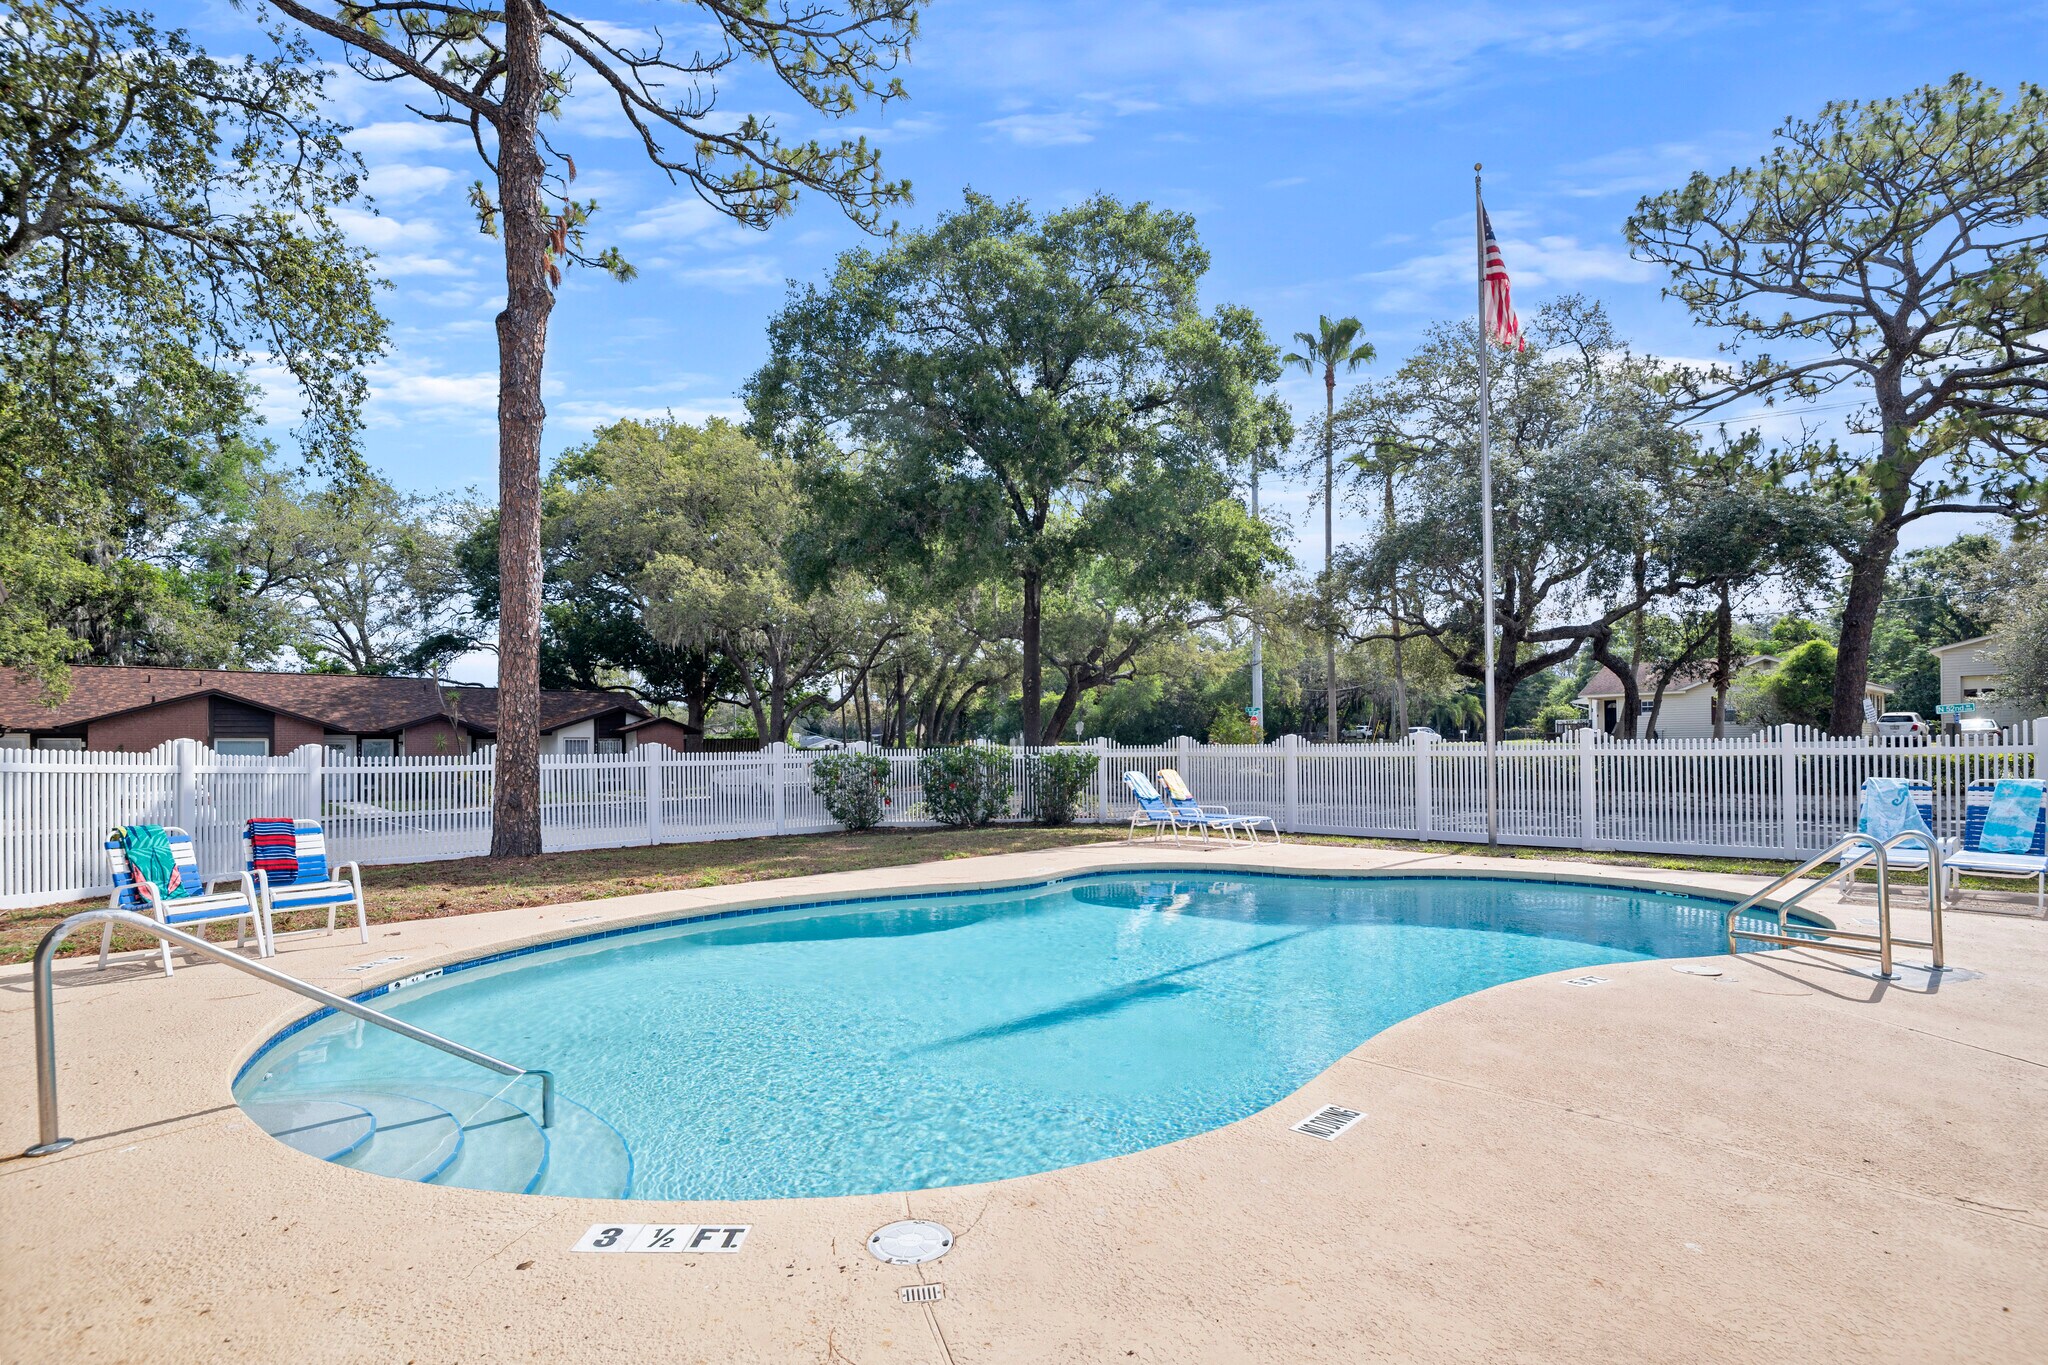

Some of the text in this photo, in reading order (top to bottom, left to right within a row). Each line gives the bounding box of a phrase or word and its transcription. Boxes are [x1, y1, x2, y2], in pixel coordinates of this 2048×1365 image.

[1298, 1107, 1360, 1138] NO DIVING
[592, 1227, 624, 1248] 3
[690, 1228, 746, 1248] FT.
